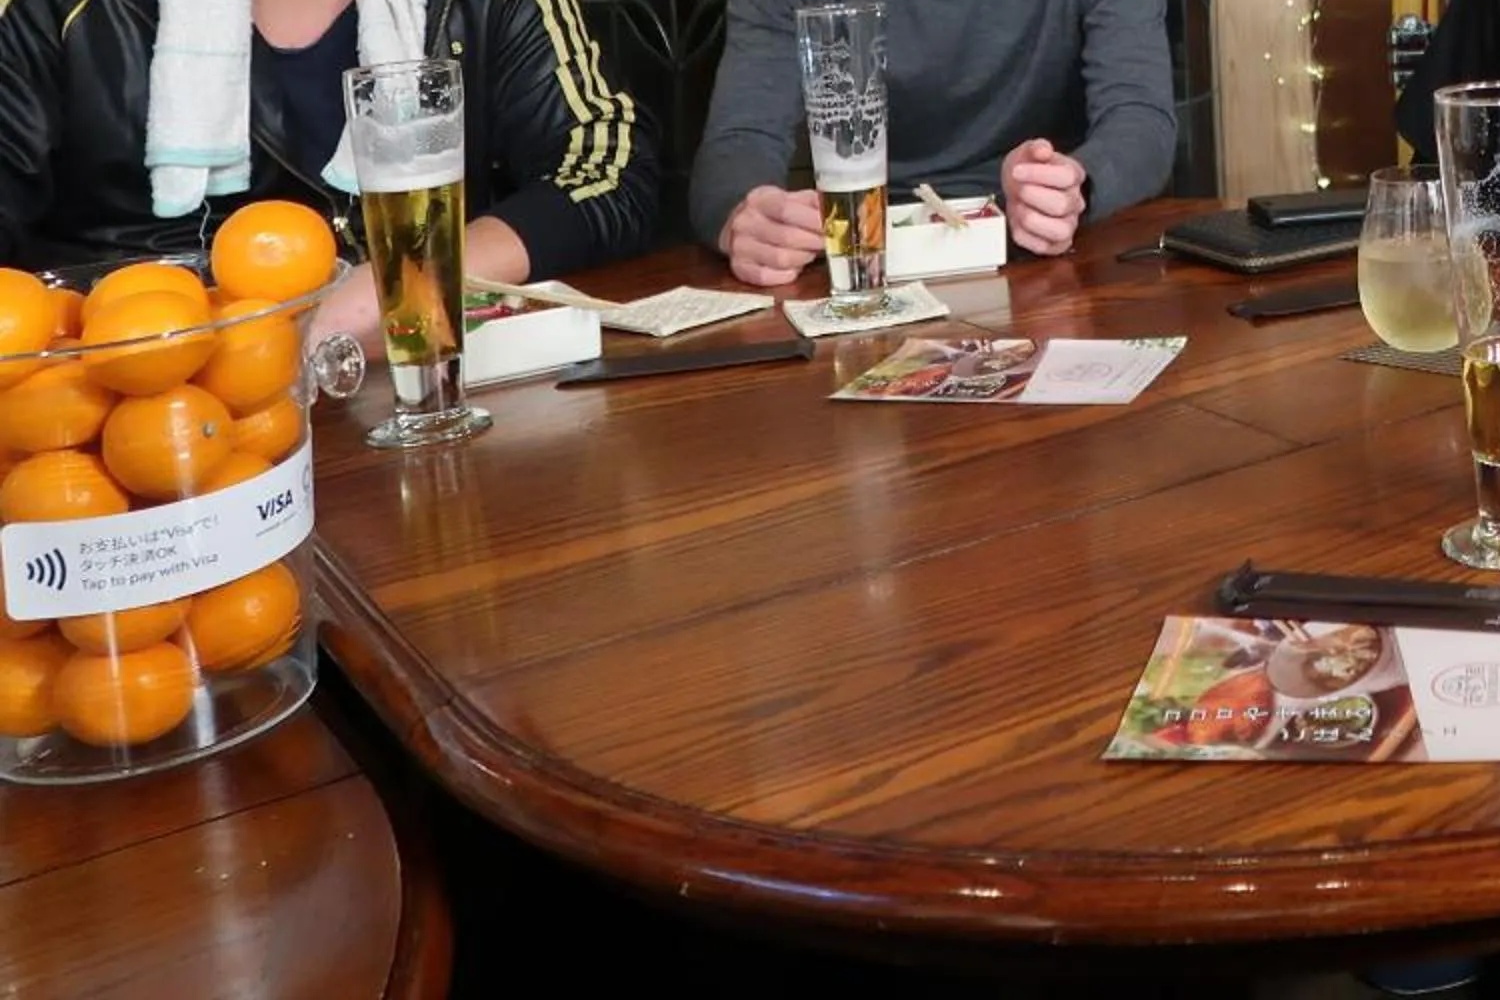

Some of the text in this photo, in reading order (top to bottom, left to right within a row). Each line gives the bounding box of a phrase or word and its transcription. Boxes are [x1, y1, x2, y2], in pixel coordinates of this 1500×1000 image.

[256, 489, 293, 520] VISA
[81, 553, 219, 591] Tap to pay with Visa
